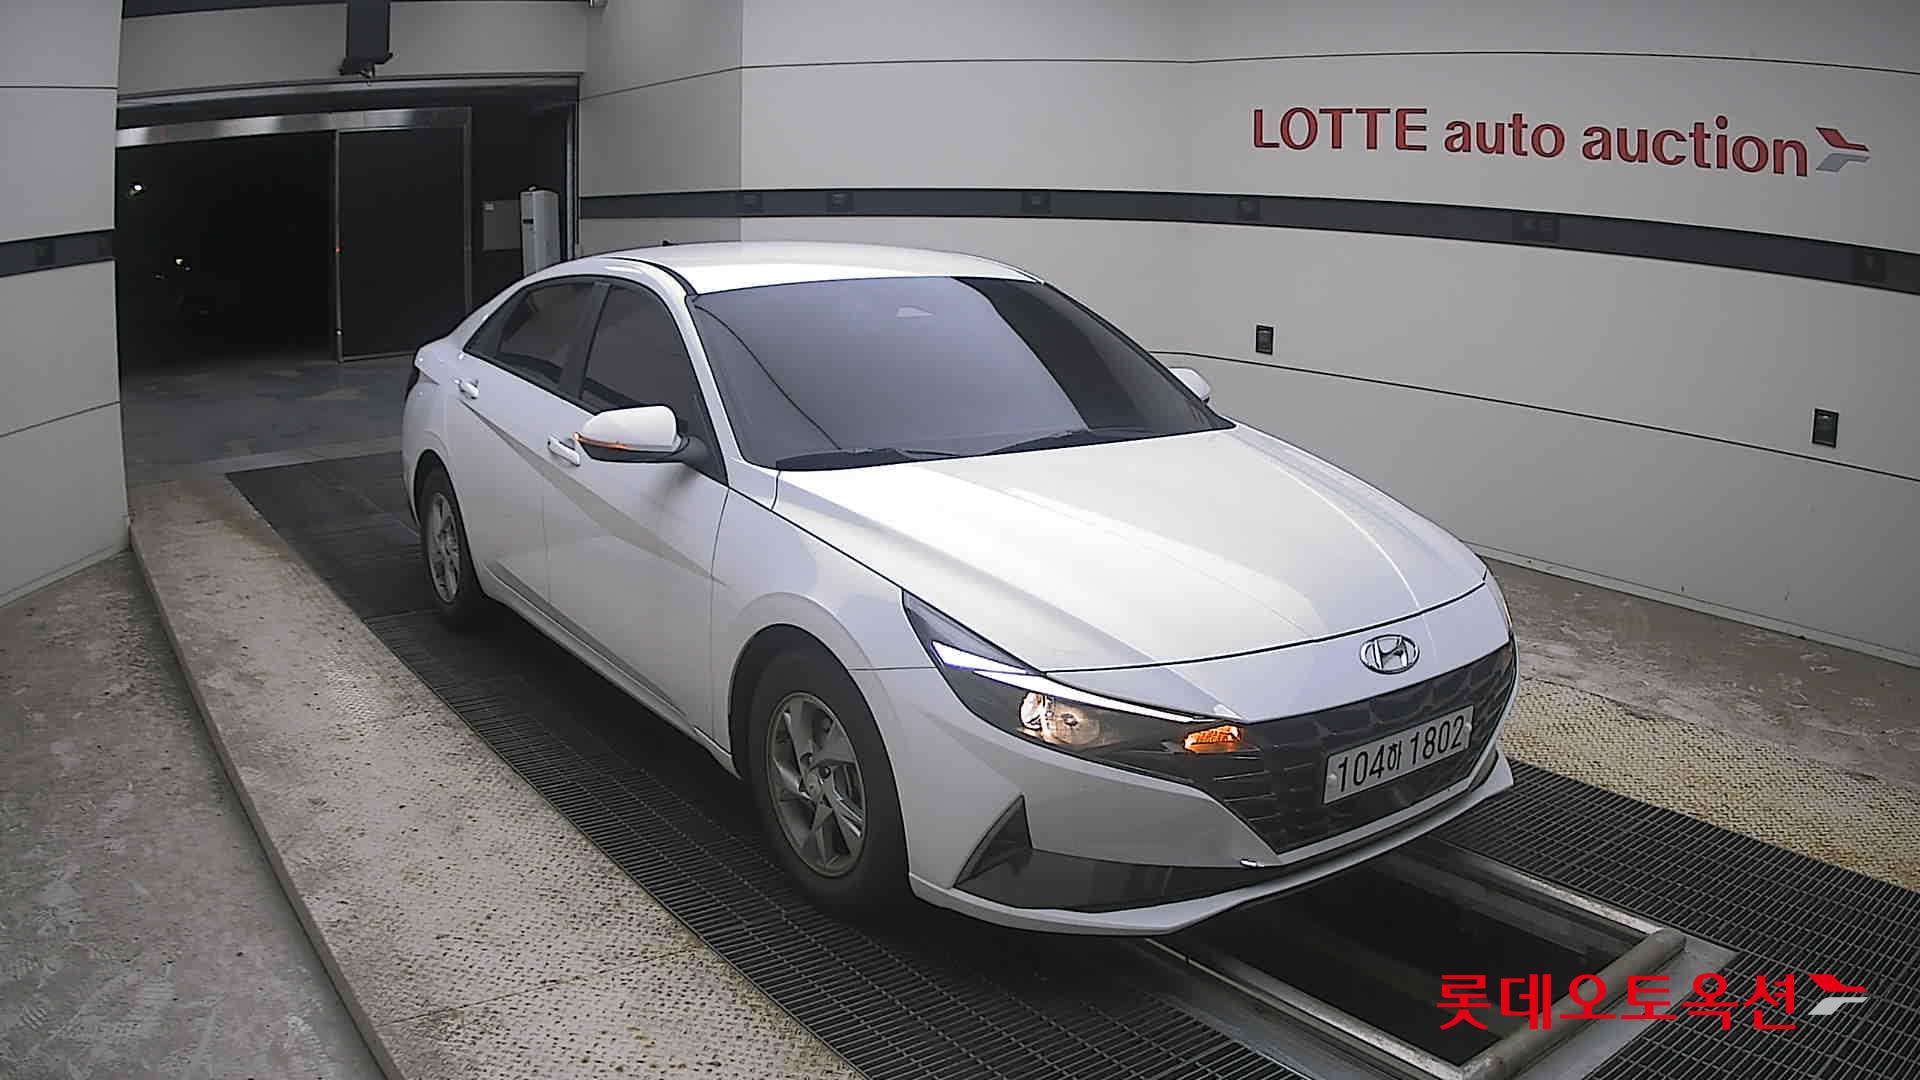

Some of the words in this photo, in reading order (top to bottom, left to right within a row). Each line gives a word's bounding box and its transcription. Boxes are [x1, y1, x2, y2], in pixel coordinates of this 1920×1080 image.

[1254, 108, 1427, 150] LOTTE
[1445, 113, 1565, 157] auto
[1582, 115, 1808, 177] auction
[1410, 714, 1465, 765] 1802
